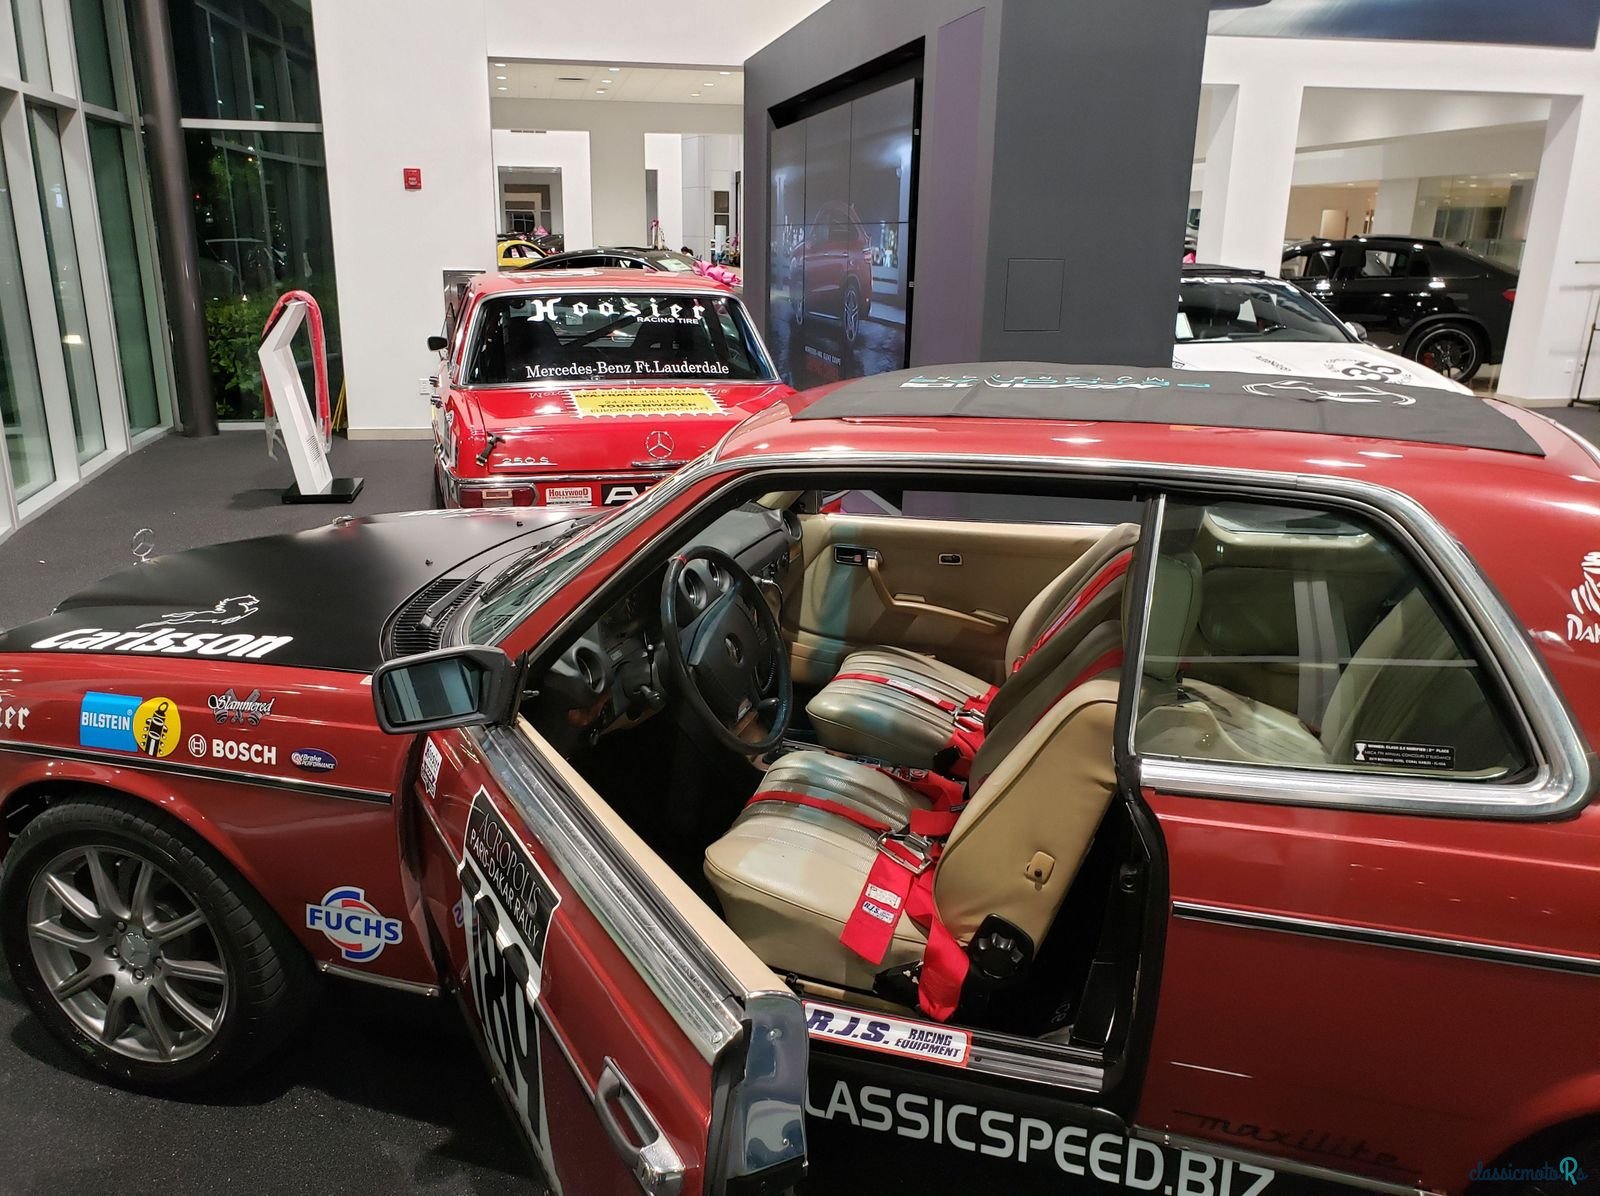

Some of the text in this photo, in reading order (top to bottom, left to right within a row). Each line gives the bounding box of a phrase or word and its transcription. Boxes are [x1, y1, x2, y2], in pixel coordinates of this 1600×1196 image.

[527, 297, 706, 321] Hoosier
[636, 316, 699, 325] RACING TIRE
[526, 361, 632, 379] Mercedes-Benz
[502, 456, 536, 464] 250
[604, 486, 653, 505] A
[81, 711, 131, 731] BILSTEIN
[212, 739, 277, 766] BOSCH
[479, 813, 543, 916] ACROPOLIS
[470, 828, 540, 946] PARIS-DAKAR RALLY
[309, 908, 399, 941] FUCHS
[808, 1009, 891, 1045] R.J.S.
[908, 1028, 953, 1047] RACING
[895, 1038, 961, 1058] EQUIPMENT
